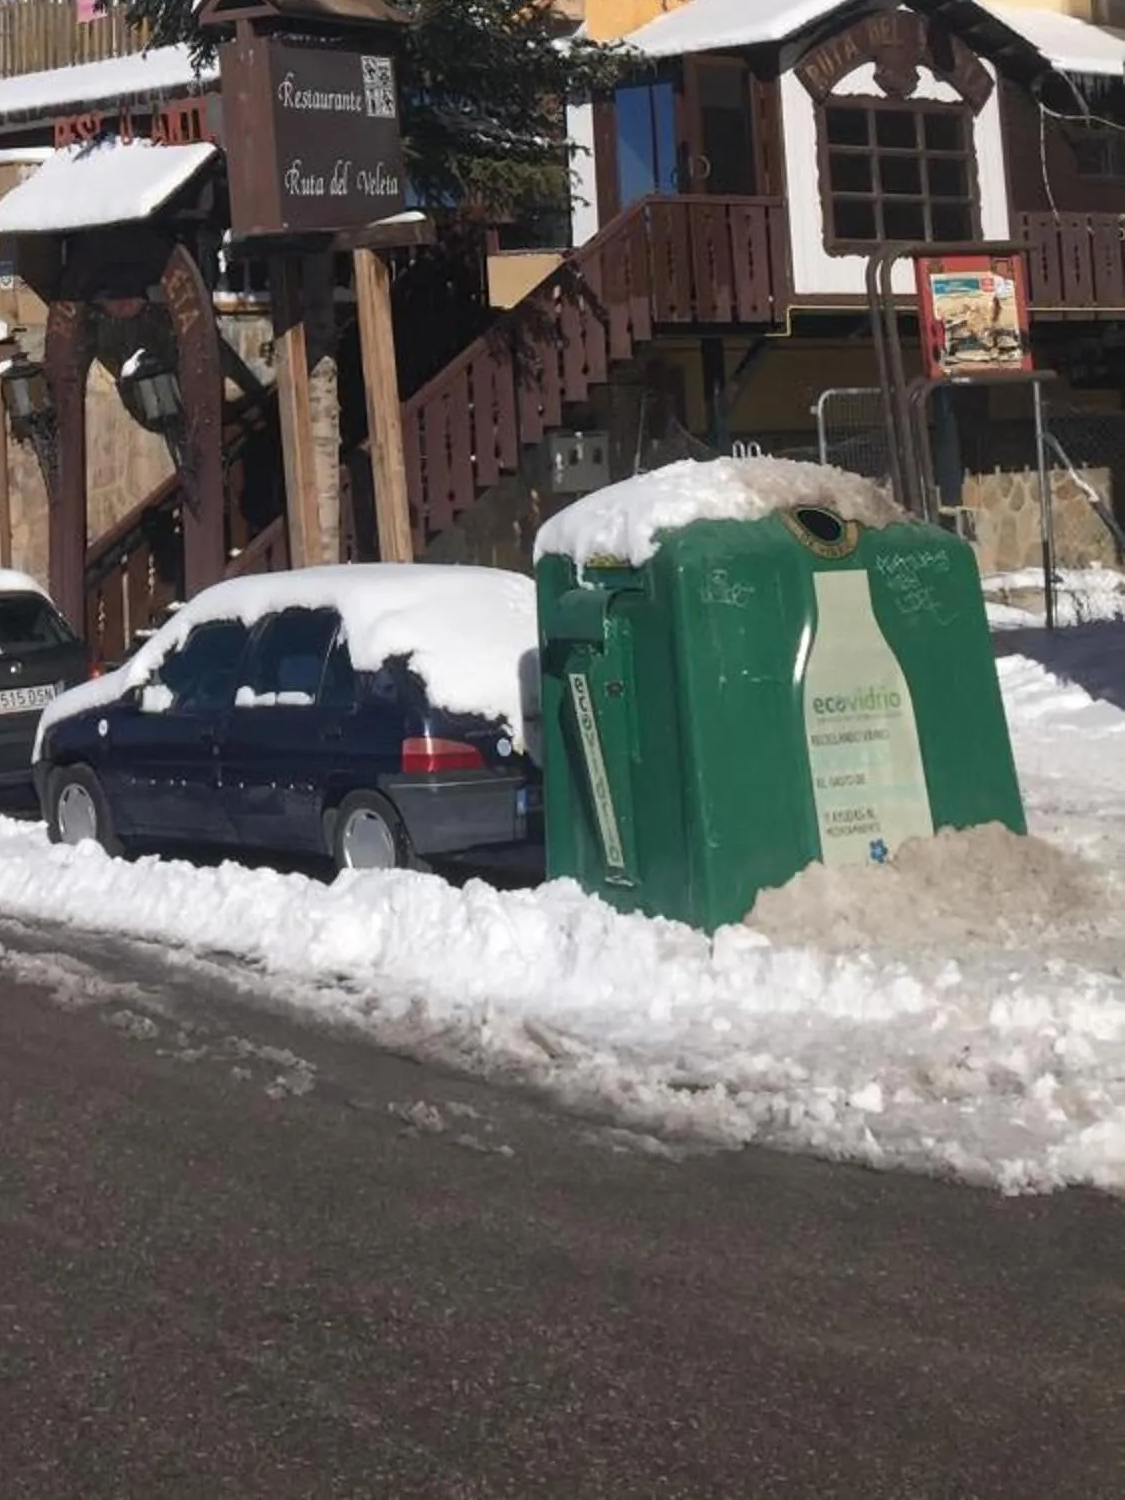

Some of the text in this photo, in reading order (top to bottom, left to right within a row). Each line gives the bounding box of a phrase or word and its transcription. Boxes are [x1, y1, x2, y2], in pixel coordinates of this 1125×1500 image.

[278, 71, 363, 112] Restaurante
[284, 159, 399, 196] Ruta del Veleta
[813, 686, 902, 714] ecovidrio
